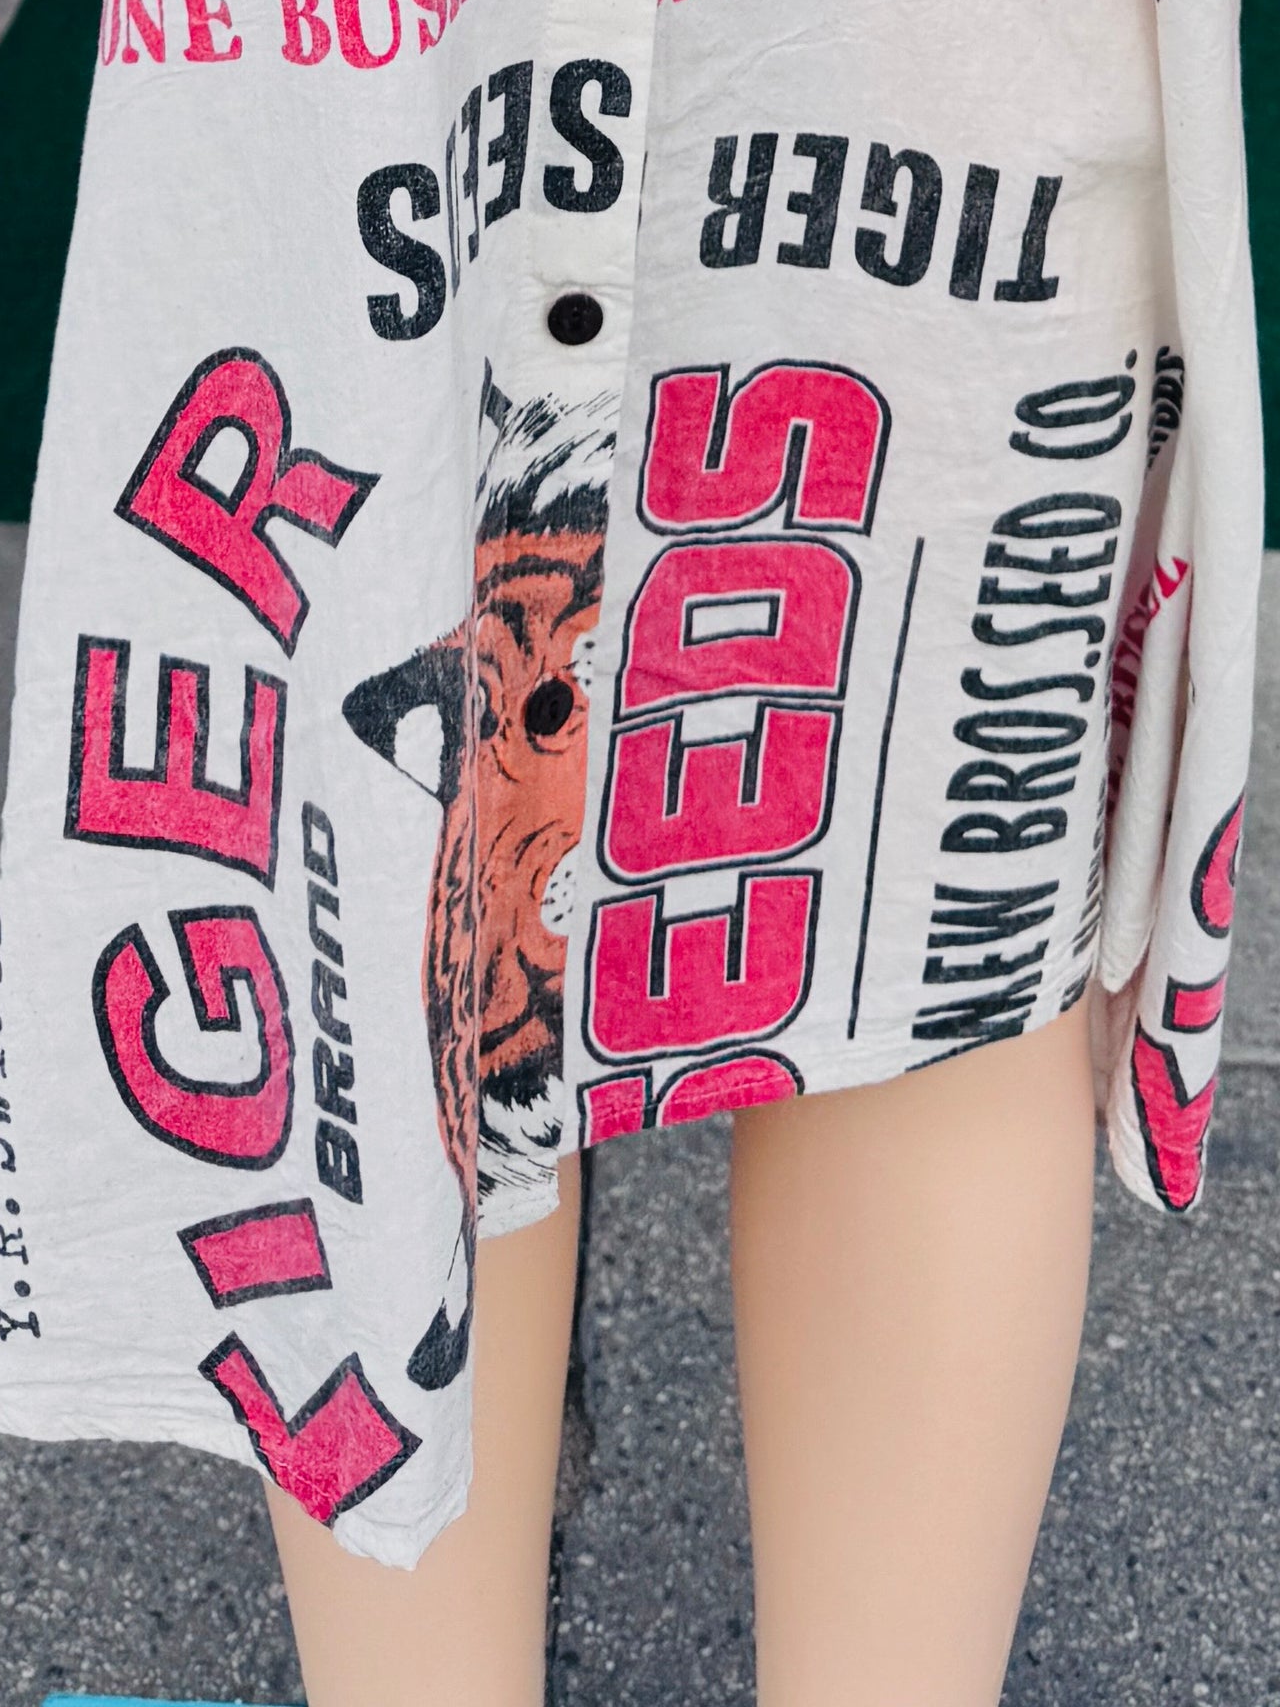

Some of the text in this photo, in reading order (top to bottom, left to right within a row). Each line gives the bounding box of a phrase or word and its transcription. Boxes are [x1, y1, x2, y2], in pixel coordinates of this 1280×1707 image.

[698, 131, 1064, 303] TIGER
[1008, 347, 1140, 460] CO.
[63, 345, 424, 1530] TIGER
[301, 799, 365, 1206] BRAND
